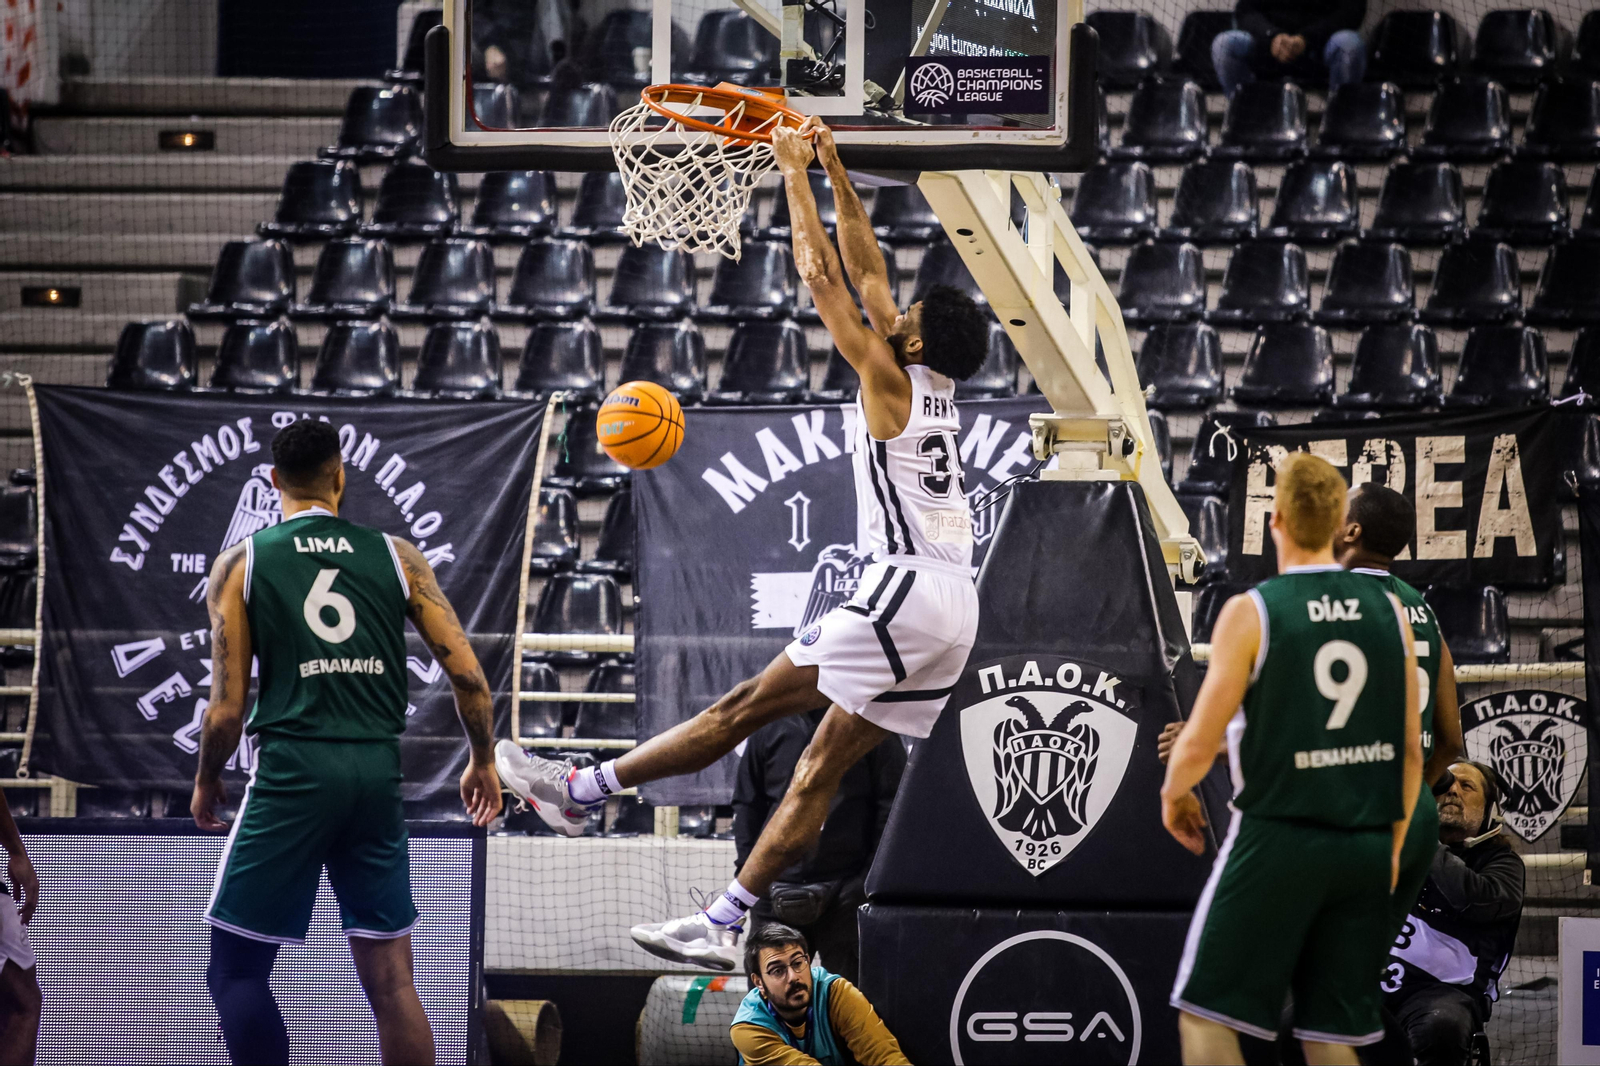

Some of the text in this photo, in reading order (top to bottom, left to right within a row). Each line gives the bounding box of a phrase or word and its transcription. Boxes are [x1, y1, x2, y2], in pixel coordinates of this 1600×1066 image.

[957, 68, 1033, 78] BASKETBALL
[957, 79, 1043, 91] CHAMPIONS
[957, 92, 1003, 102] LEAGUE
[294, 536, 354, 553] LIMA
[170, 553, 206, 573] THE
[303, 569, 356, 644] 6
[1306, 594, 1361, 623] DÍAZ
[299, 656, 385, 678] BENAHAVÍS
[1313, 639, 1368, 730] 9
[1012, 735, 1082, 756] ΠΑΟΚ
[1294, 741, 1395, 769] BENAHAVÍS
[1514, 816, 1547, 828] 1926
[1014, 839, 1062, 857] 1926
[1027, 858, 1046, 870] BC
[967, 1011, 1125, 1042] GSA
